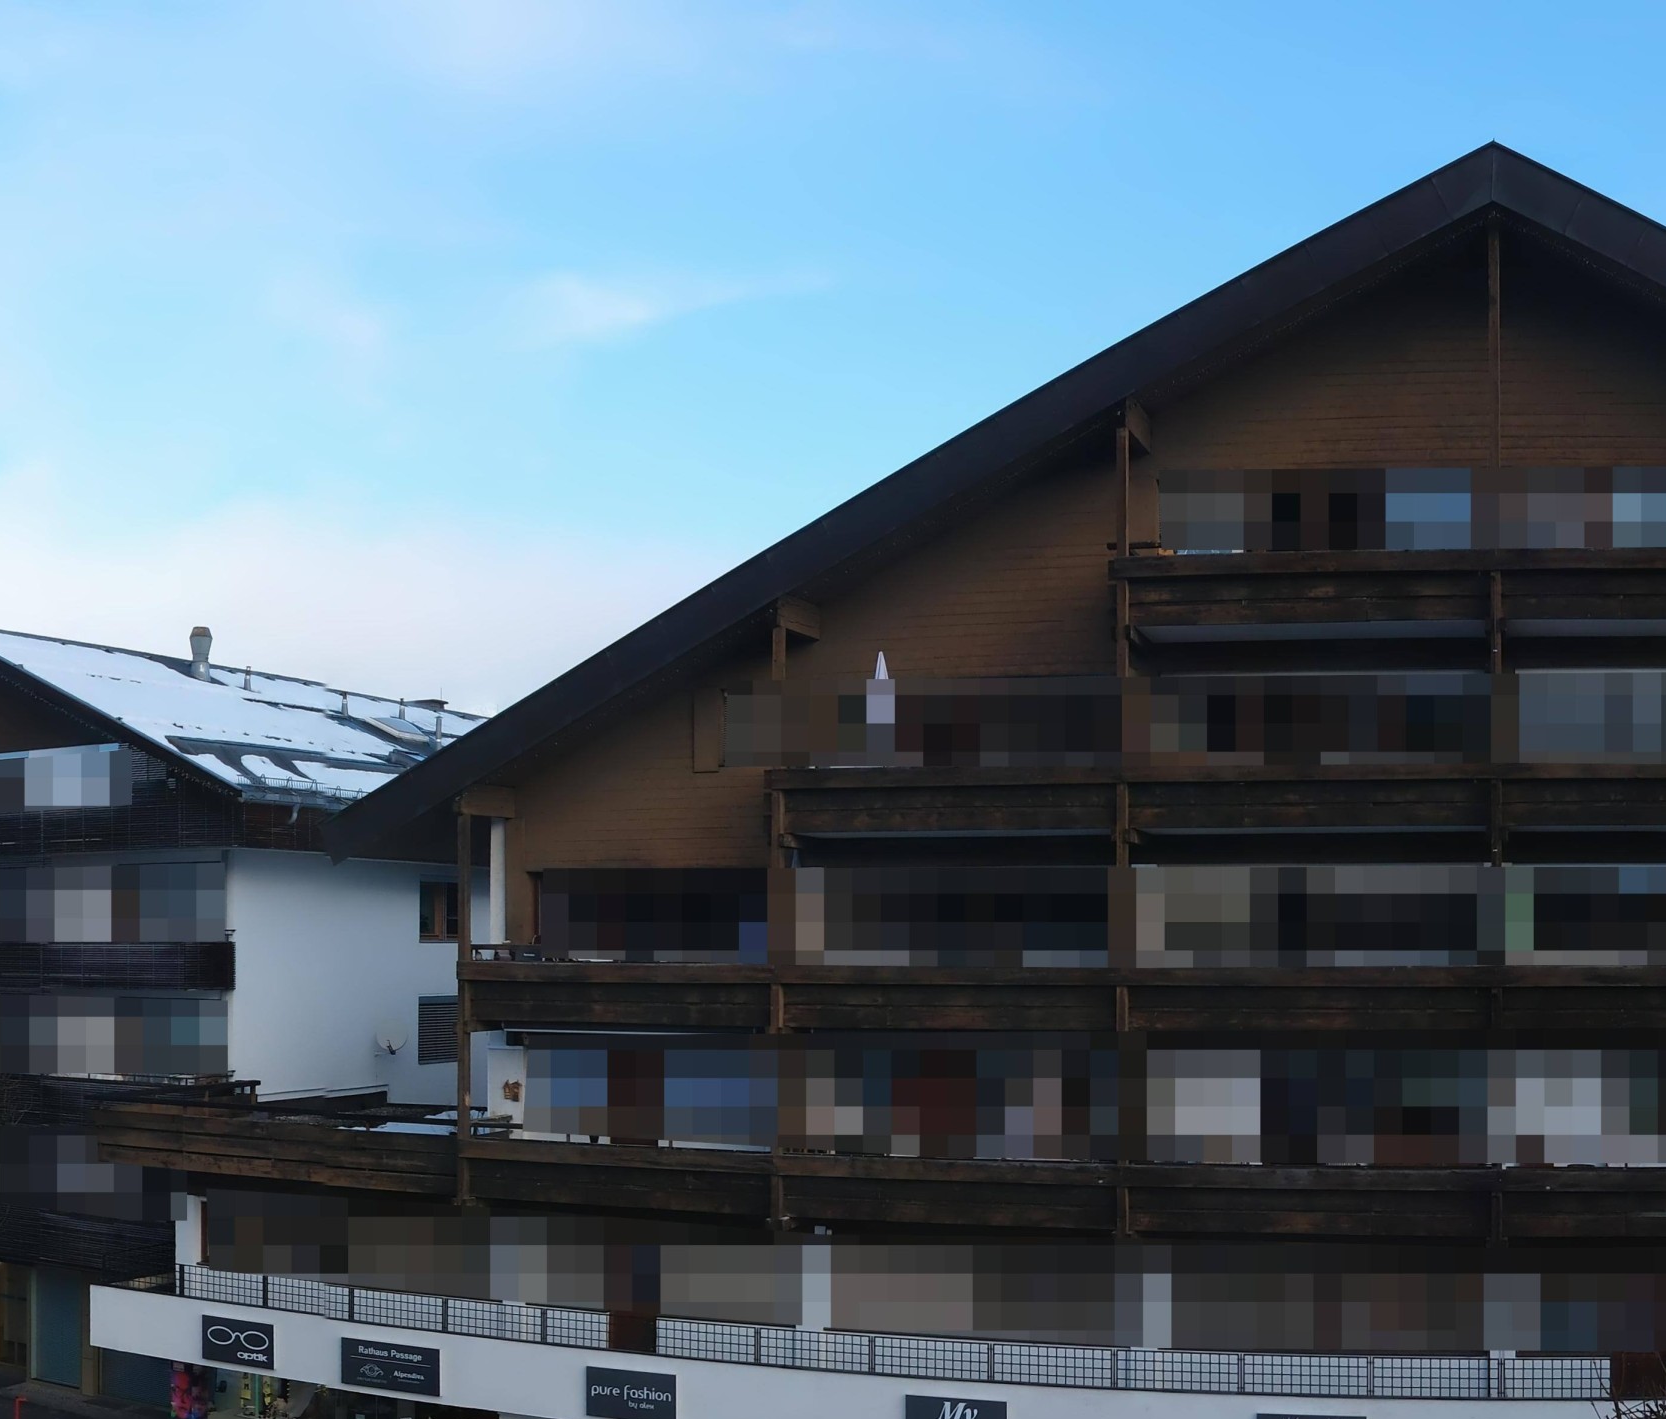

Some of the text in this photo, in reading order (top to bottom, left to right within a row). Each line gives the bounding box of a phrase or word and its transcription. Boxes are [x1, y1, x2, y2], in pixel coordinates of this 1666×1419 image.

[237, 1350, 269, 1363] optik
[358, 1345, 423, 1362] Rathaus Passage
[591, 1384, 672, 1402] pure fashion
[628, 1400, 655, 1410] by alex
